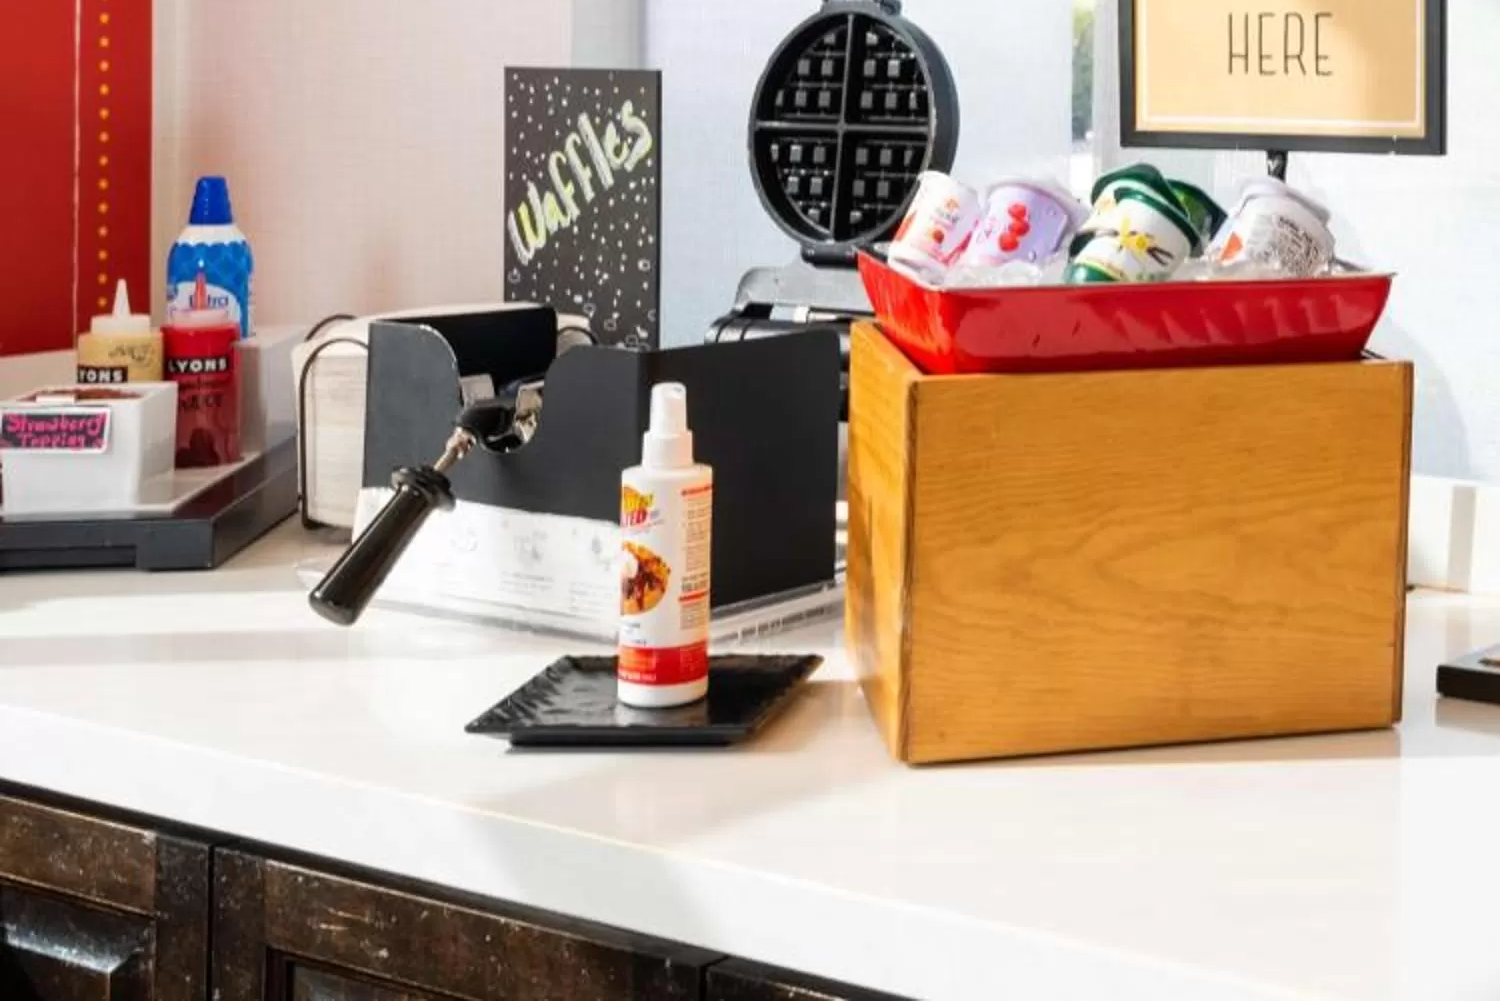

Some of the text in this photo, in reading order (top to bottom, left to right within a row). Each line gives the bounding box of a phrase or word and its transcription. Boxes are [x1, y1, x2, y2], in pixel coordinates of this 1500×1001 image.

[1227, 12, 1335, 77] HERE
[507, 99, 653, 266] Waffles
[168, 357, 227, 372] LYONS
